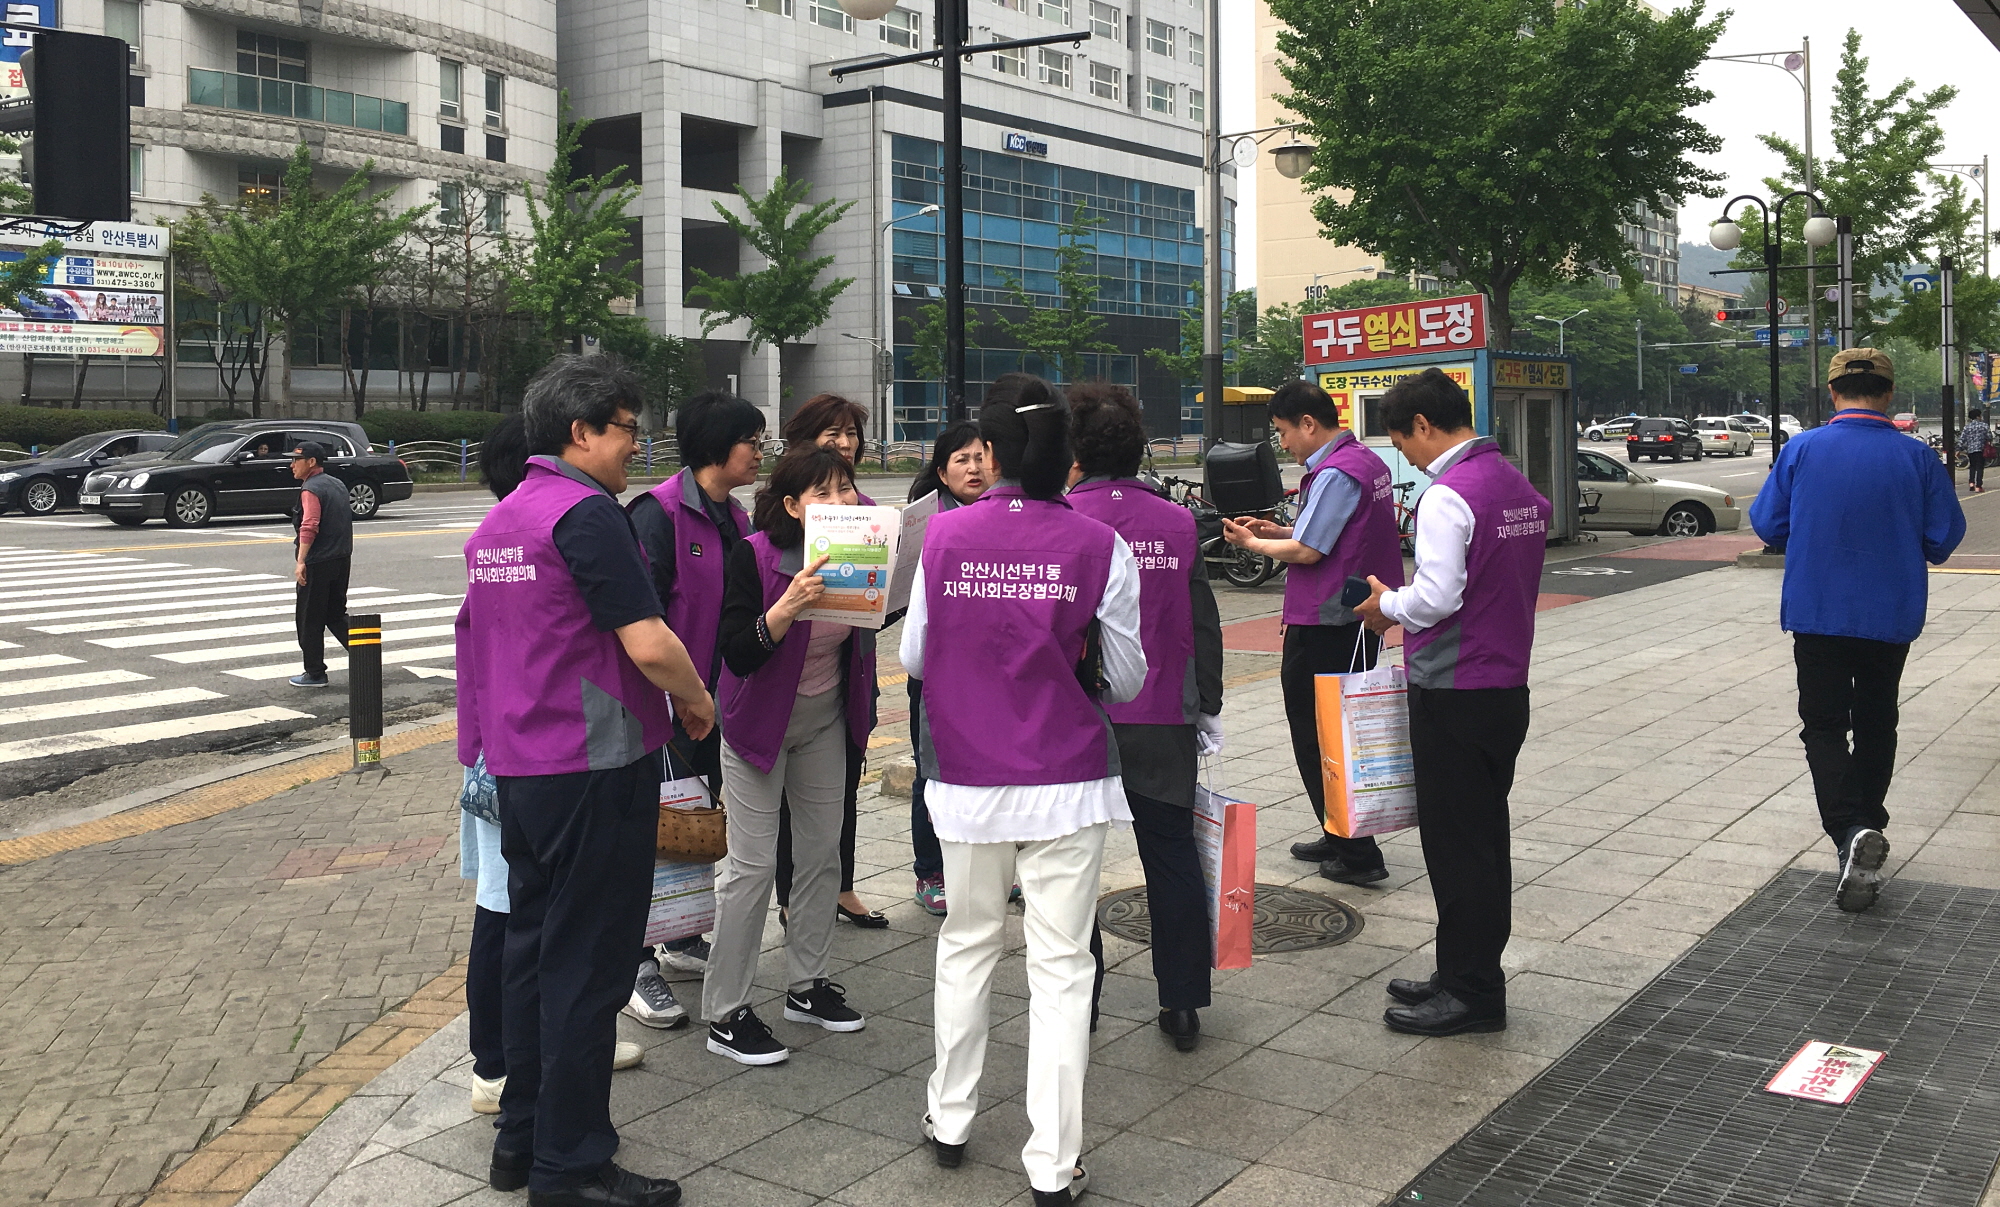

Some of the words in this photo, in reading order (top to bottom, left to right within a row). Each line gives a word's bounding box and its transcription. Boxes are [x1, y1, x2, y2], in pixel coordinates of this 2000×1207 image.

[1009, 135, 1024, 149] KCC
[102, 230, 159, 249] 안산특별시
[96, 270, 163, 280] www.awcc.or.kr
[1304, 284, 1329, 300] 1503
[1913, 281, 1928, 294] P
[1325, 376, 1348, 390] 도장
[1505, 362, 1521, 384] 구두
[1528, 363, 1544, 385] 열쇠
[1550, 364, 1565, 386] 도장
[476, 545, 524, 565] 안산시선부1동
[469, 564, 537, 584] 지역사회보장협의체
[960, 561, 1062, 581] 안산시선부1동
[942, 580, 1078, 603] 지역사회보장협의체
